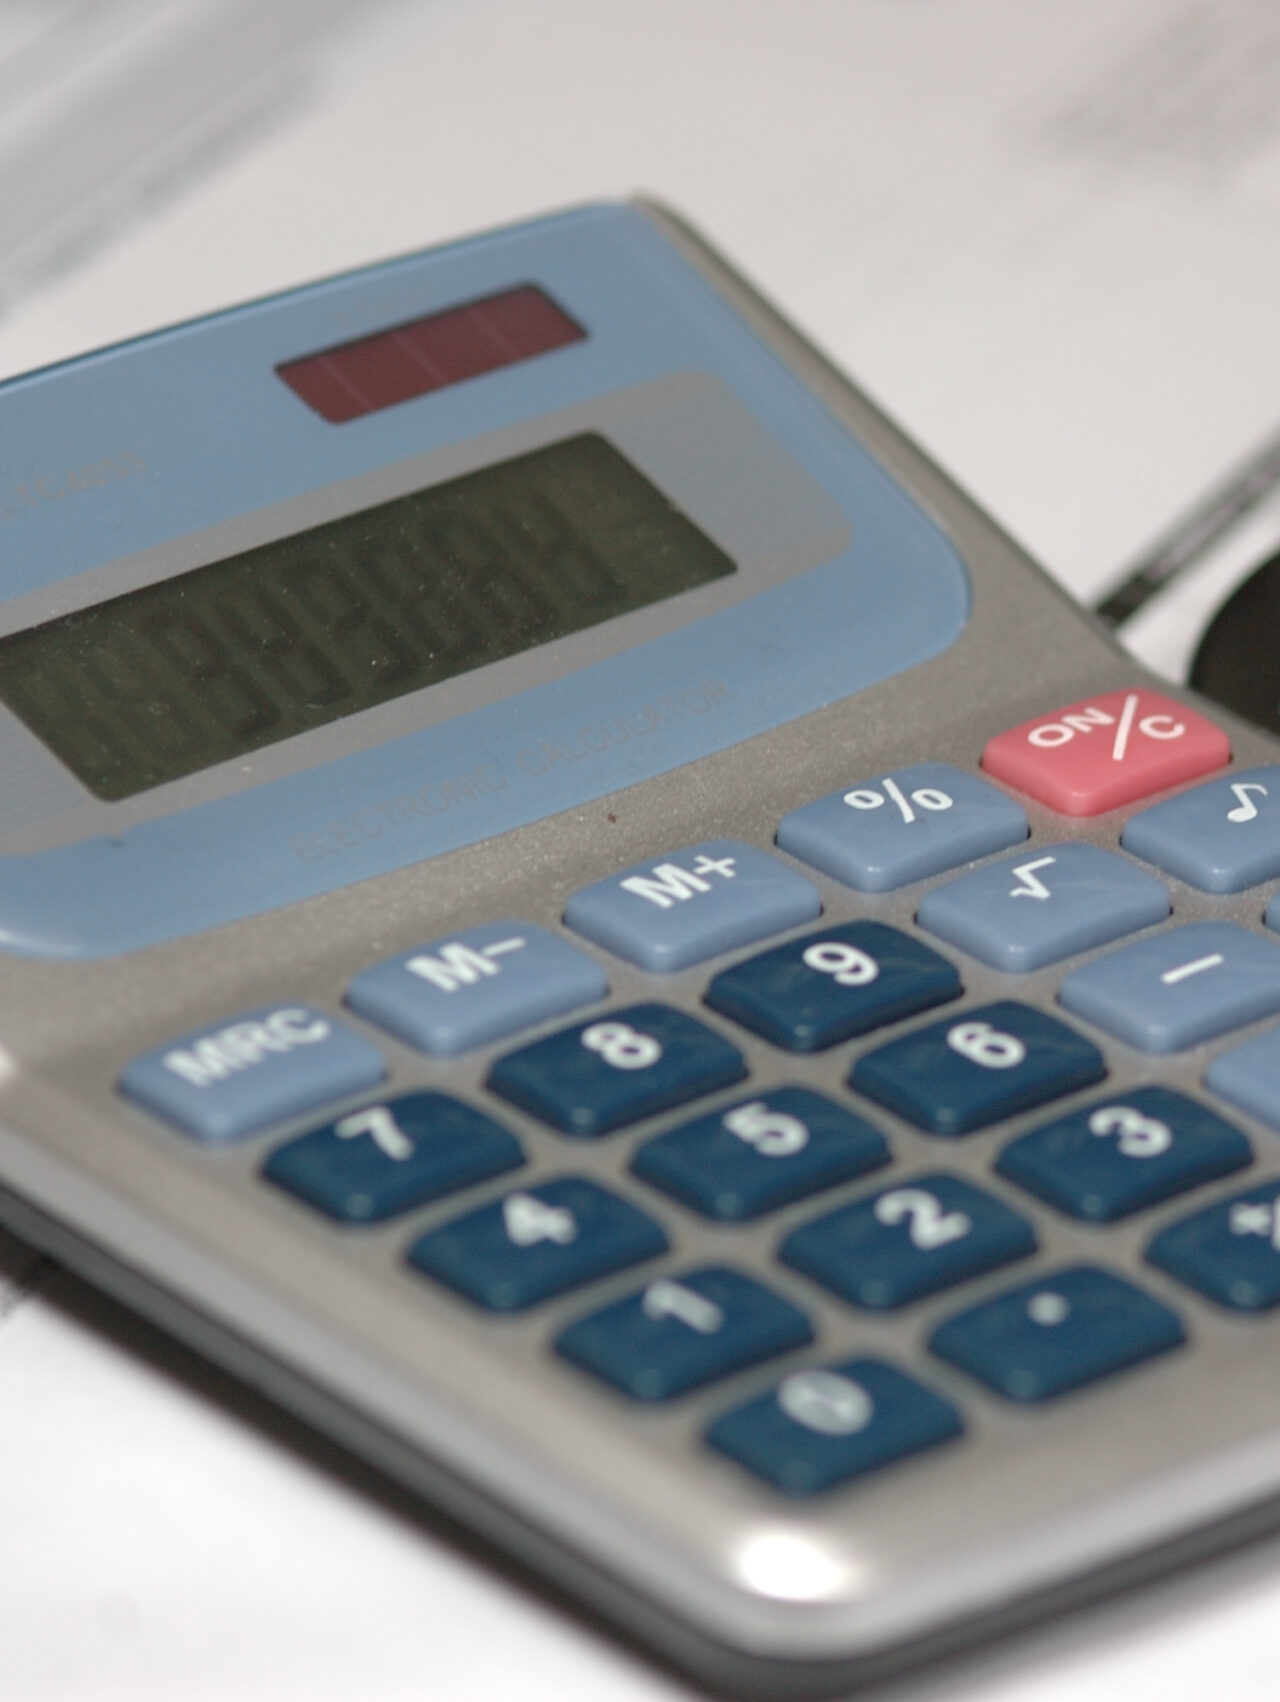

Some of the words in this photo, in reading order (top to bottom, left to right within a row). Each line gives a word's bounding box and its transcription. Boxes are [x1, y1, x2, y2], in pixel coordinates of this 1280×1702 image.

[1028, 693, 1187, 761] ON/C
[288, 763, 508, 864] ELECTRONIC
[515, 679, 737, 776] CALCULATOR
[620, 853, 737, 909] M+
[802, 941, 880, 987] 9
[163, 1007, 332, 1088] MRC
[581, 1021, 663, 1070] 8
[947, 1021, 1025, 1068] 6
[334, 1105, 414, 1163] 7
[722, 1100, 810, 1157] 5
[1090, 1105, 1173, 1159] 3
[502, 1192, 578, 1248] 4
[874, 1187, 971, 1250] 2
[641, 1279, 724, 1334] 1
[776, 1368, 874, 1437] 0
